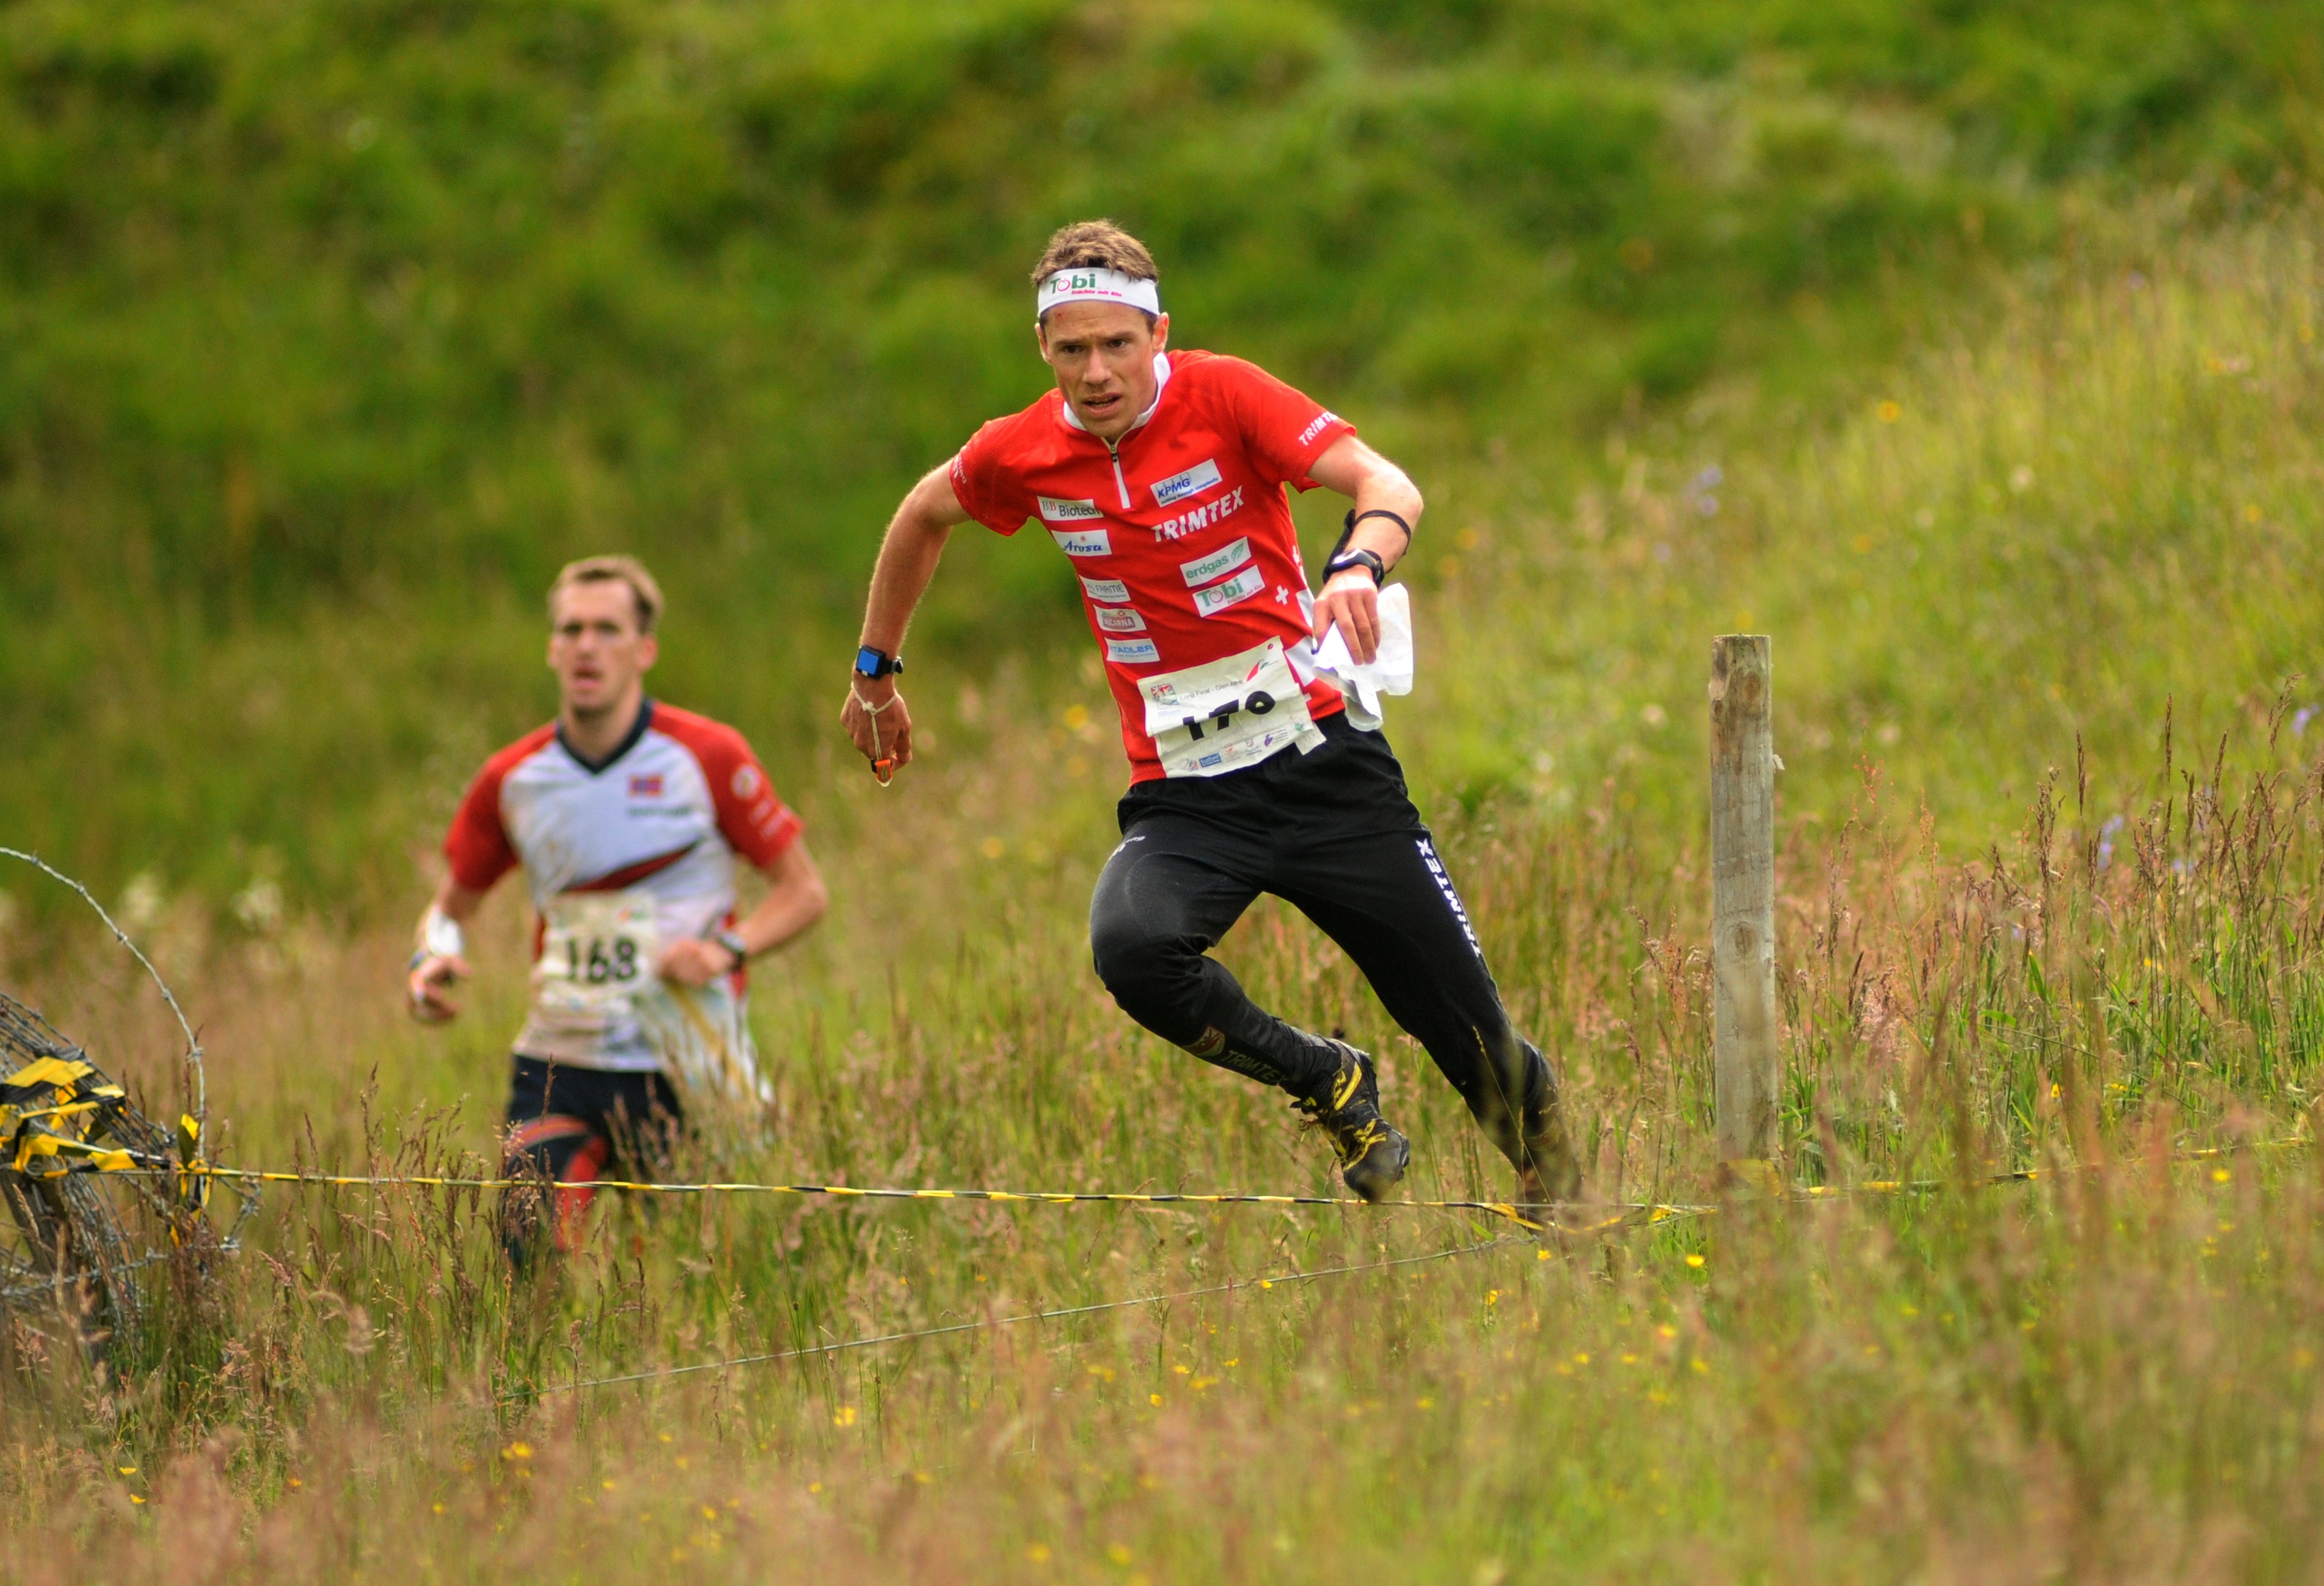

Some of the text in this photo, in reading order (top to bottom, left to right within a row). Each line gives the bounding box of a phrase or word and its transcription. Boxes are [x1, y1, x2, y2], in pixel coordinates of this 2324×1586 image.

[1050, 273, 1096, 294] Tobi
[1158, 478, 1191, 498] KPMG
[1043, 501, 1056, 511] BB
[1151, 486, 1244, 542] TRIMTEX
[1186, 556, 1229, 578] erdgas
[1196, 578, 1243, 607] Tobi
[1180, 692, 1195, 701] Long
[1196, 688, 1211, 697] Final
[1215, 683, 1229, 691] Glen
[1416, 838, 1481, 958] TRIMTEX
[567, 935, 638, 985] 168
